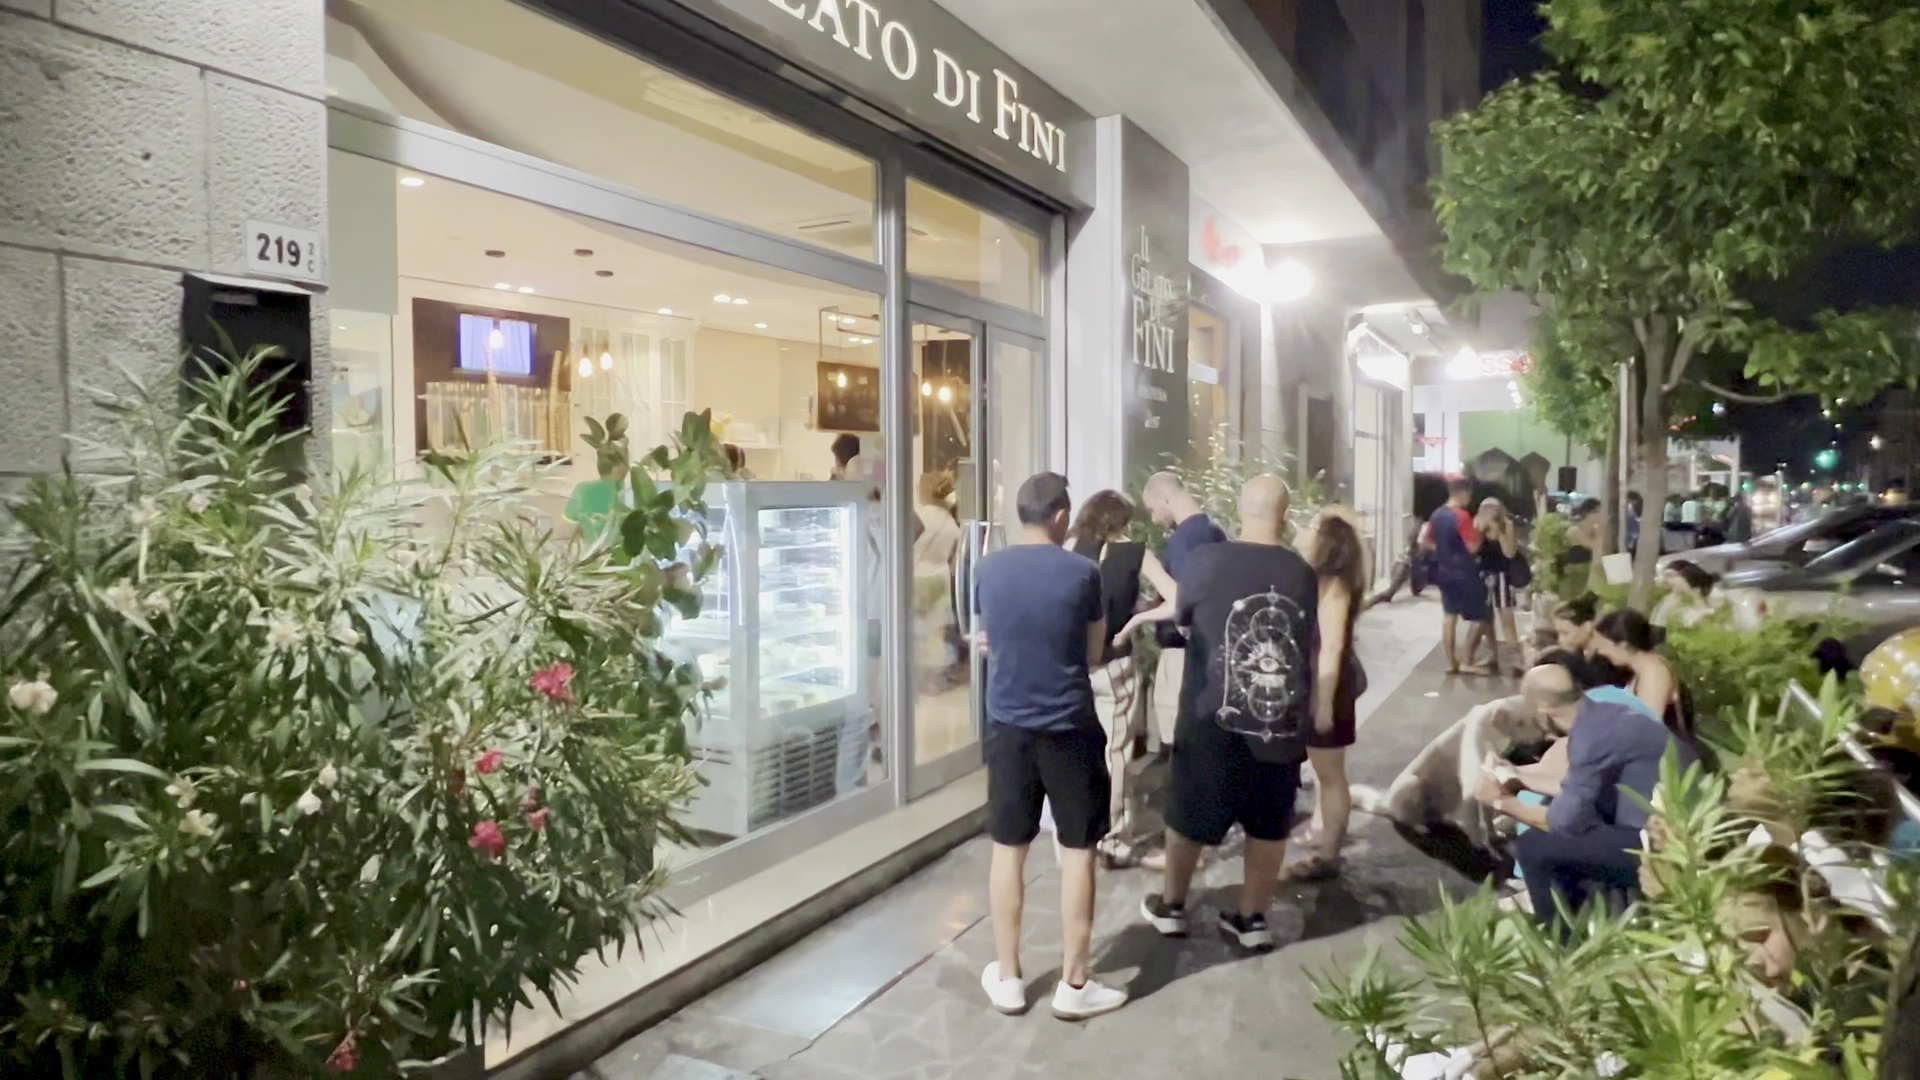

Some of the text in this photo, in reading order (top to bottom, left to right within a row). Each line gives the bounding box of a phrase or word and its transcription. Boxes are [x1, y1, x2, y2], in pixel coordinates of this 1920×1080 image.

[767, 0, 1066, 172] ATO DI FINI
[256, 232, 301, 267] 219
[1132, 295, 1174, 373] FINI
